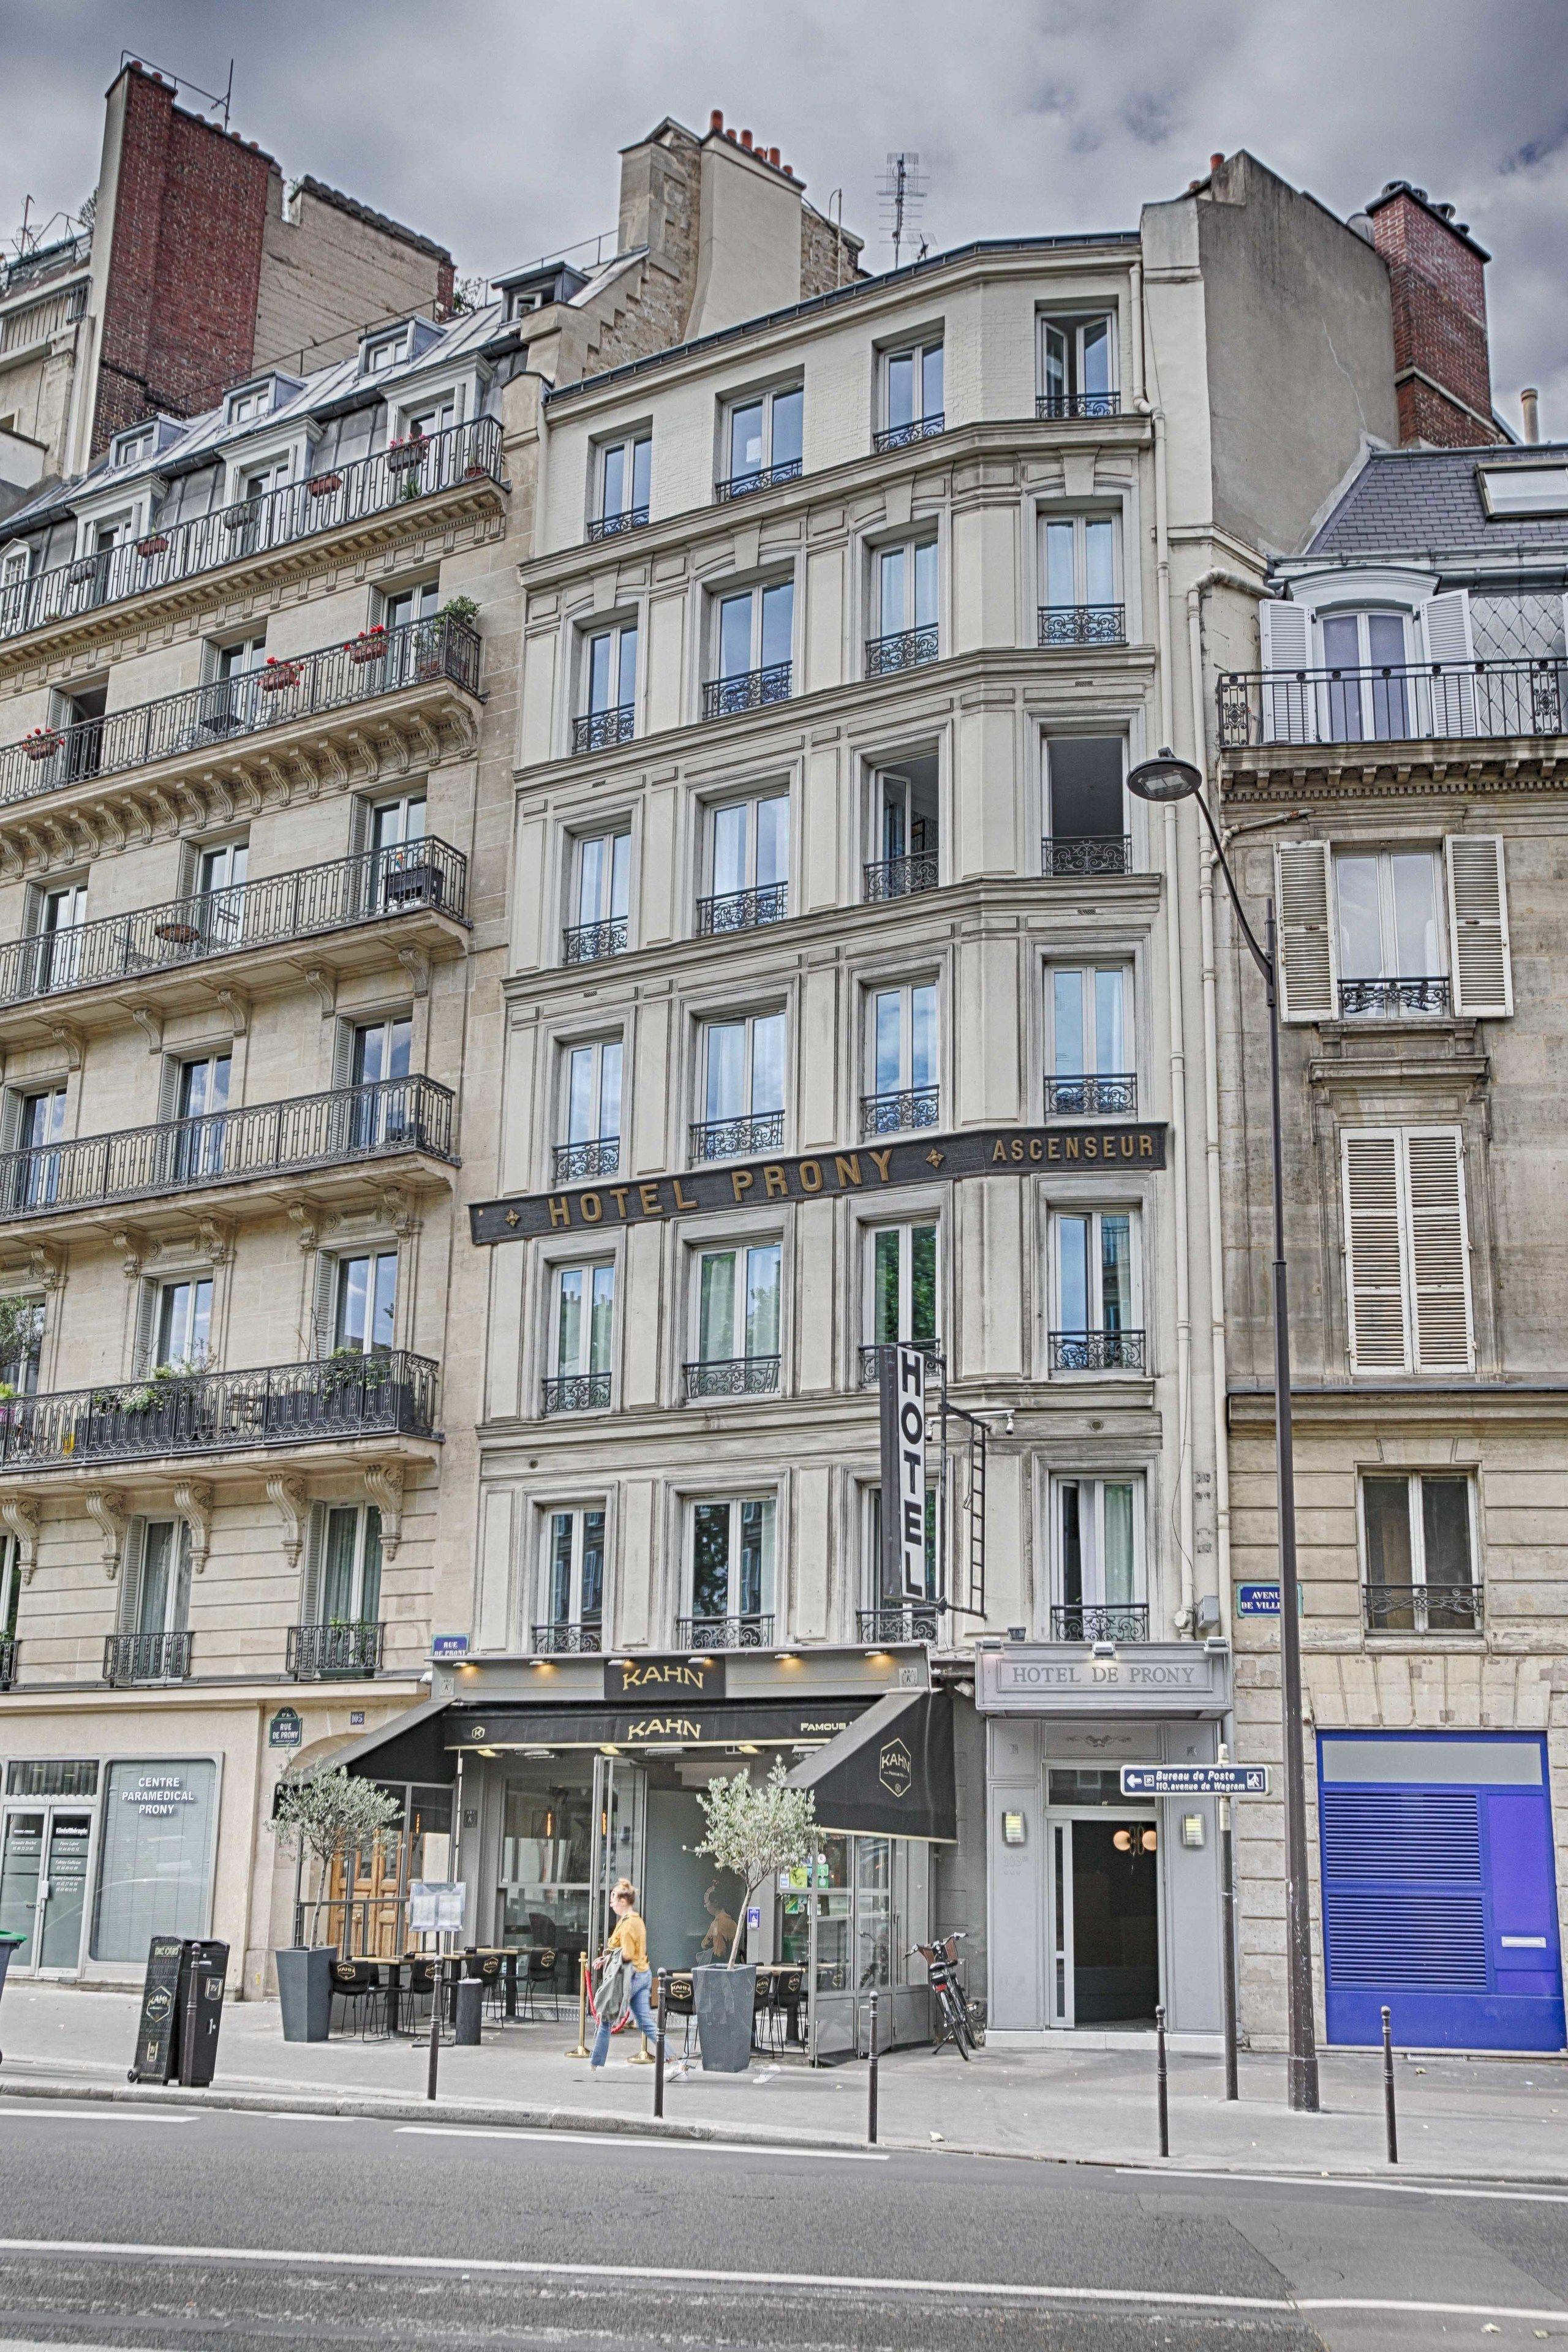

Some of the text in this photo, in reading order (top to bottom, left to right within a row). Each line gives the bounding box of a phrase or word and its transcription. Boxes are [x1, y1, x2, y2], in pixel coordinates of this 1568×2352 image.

[992, 1135, 1153, 1163] ASCENSEUR
[548, 1149, 893, 1227] HOTEL PRONY
[901, 1350, 923, 1597] HOTEL
[1252, 1591, 1280, 1600] AVENU
[623, 1665, 704, 1691] KAHN
[1012, 1667, 1194, 1684] HOTEL DE PRONY
[628, 1719, 701, 1741] KAHN
[881, 1754, 911, 1773] KAHN
[138, 1777, 180, 1787] CENTRE
[1156, 1771, 1235, 1781] Bureau de Poste
[1200, 1782, 1210, 1791] de
[1214, 1782, 1246, 1792] Wagram
[122, 1791, 195, 1801] PARAMEDICAL
[138, 1804, 175, 1814] PRONY
[148, 1995, 170, 2006] KAHN
